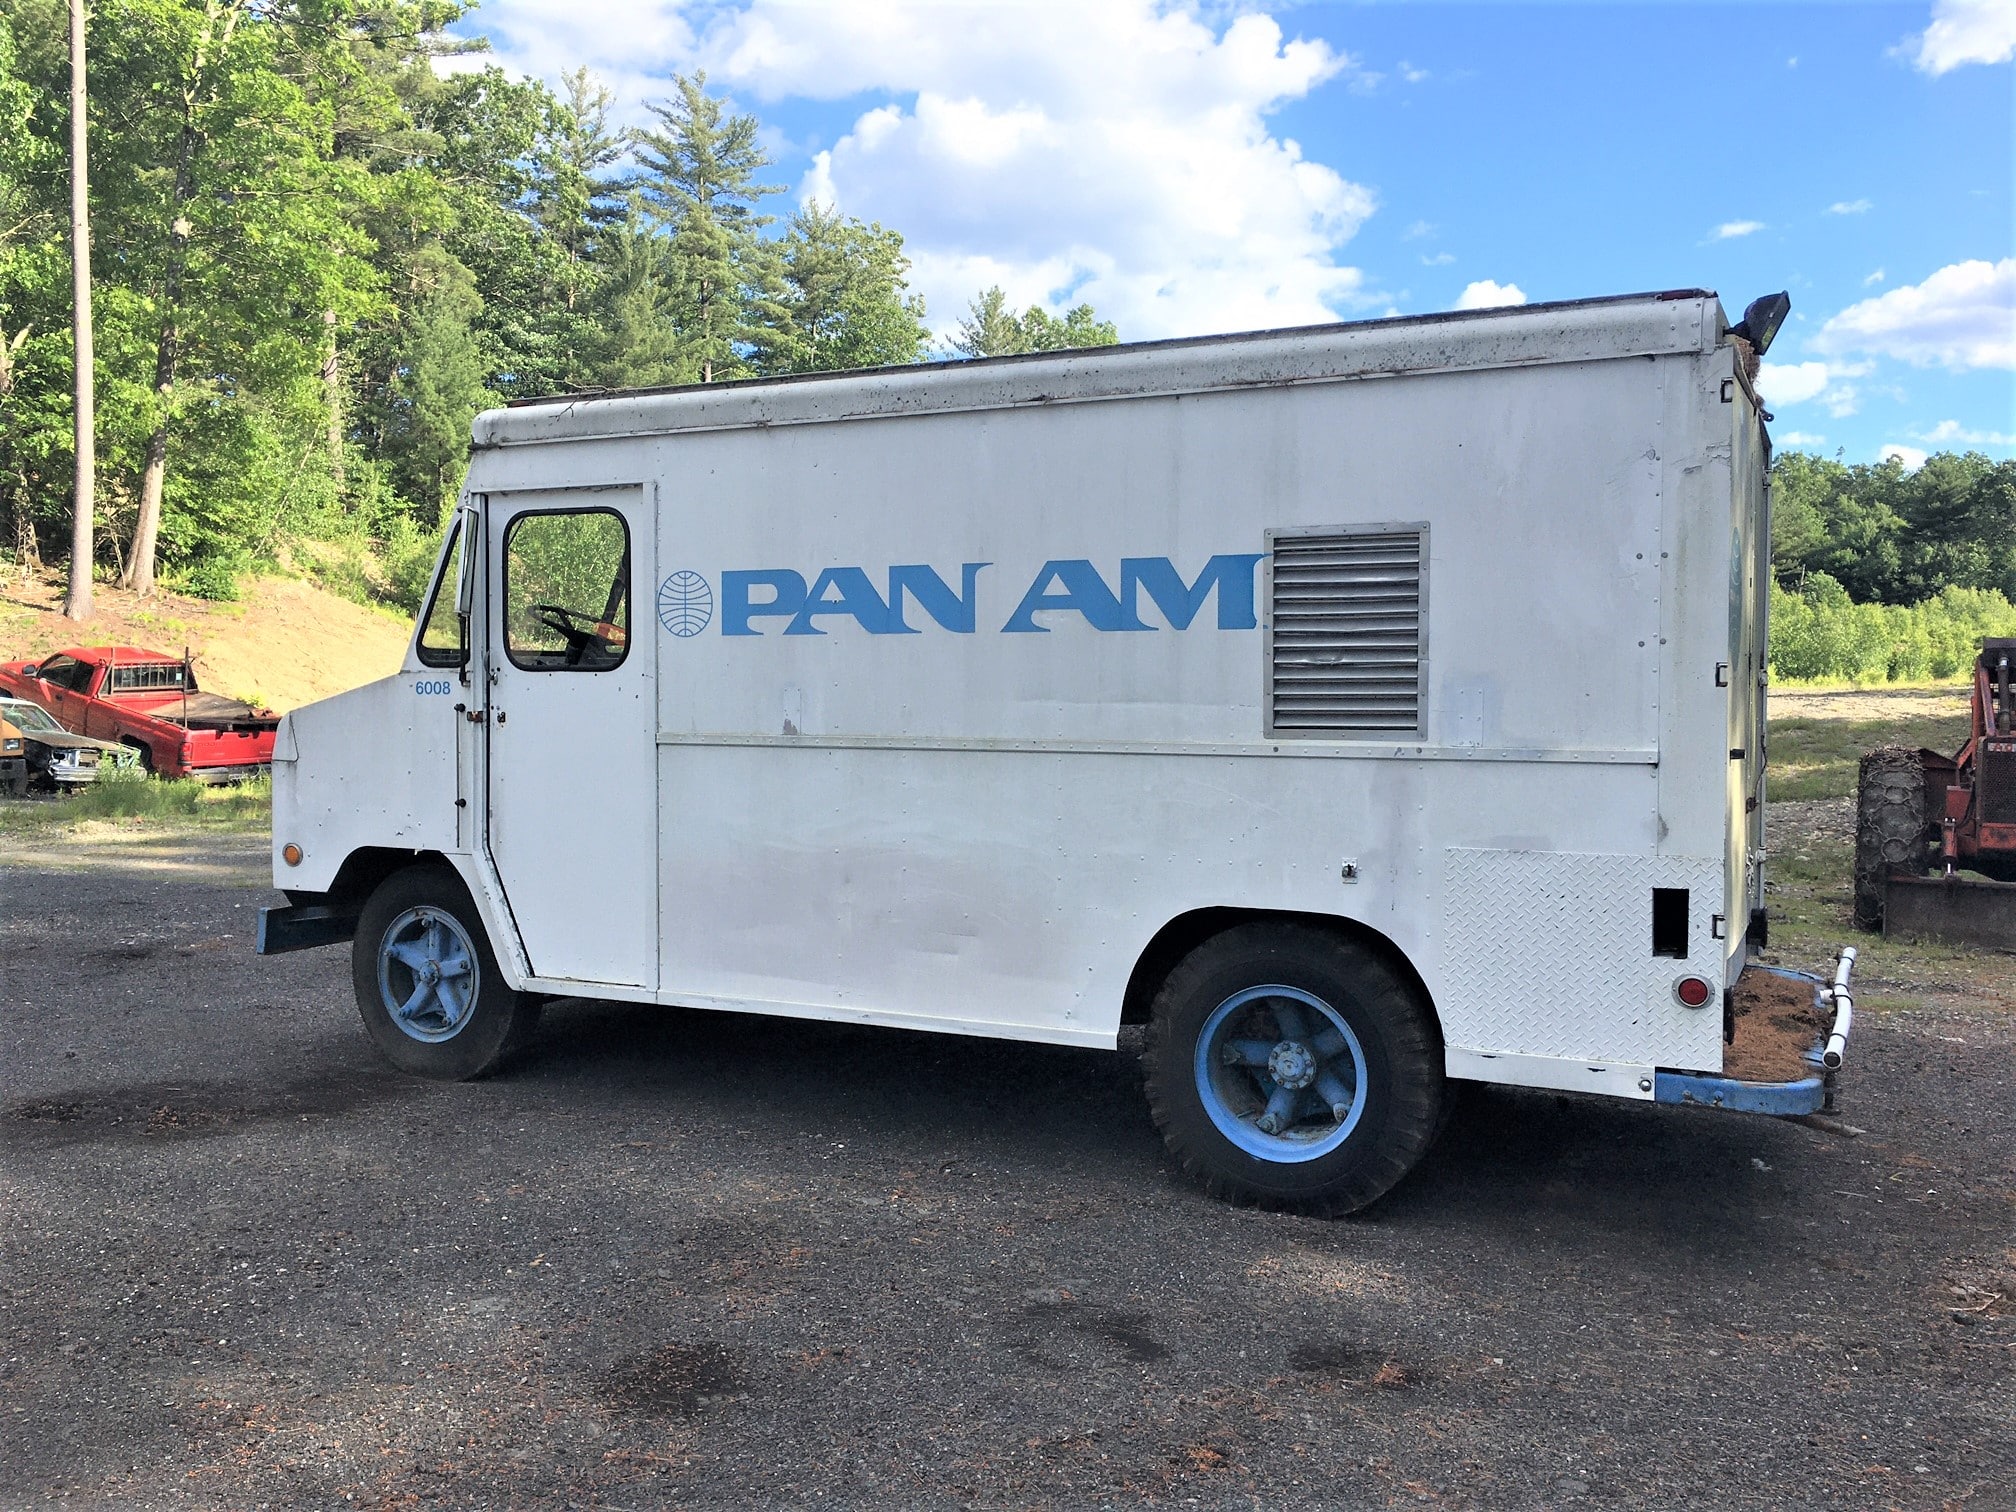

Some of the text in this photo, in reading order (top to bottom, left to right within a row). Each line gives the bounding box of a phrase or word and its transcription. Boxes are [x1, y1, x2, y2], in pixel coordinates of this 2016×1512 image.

[721, 553, 1272, 636] PAN AM
[415, 681, 451, 695] 6008
